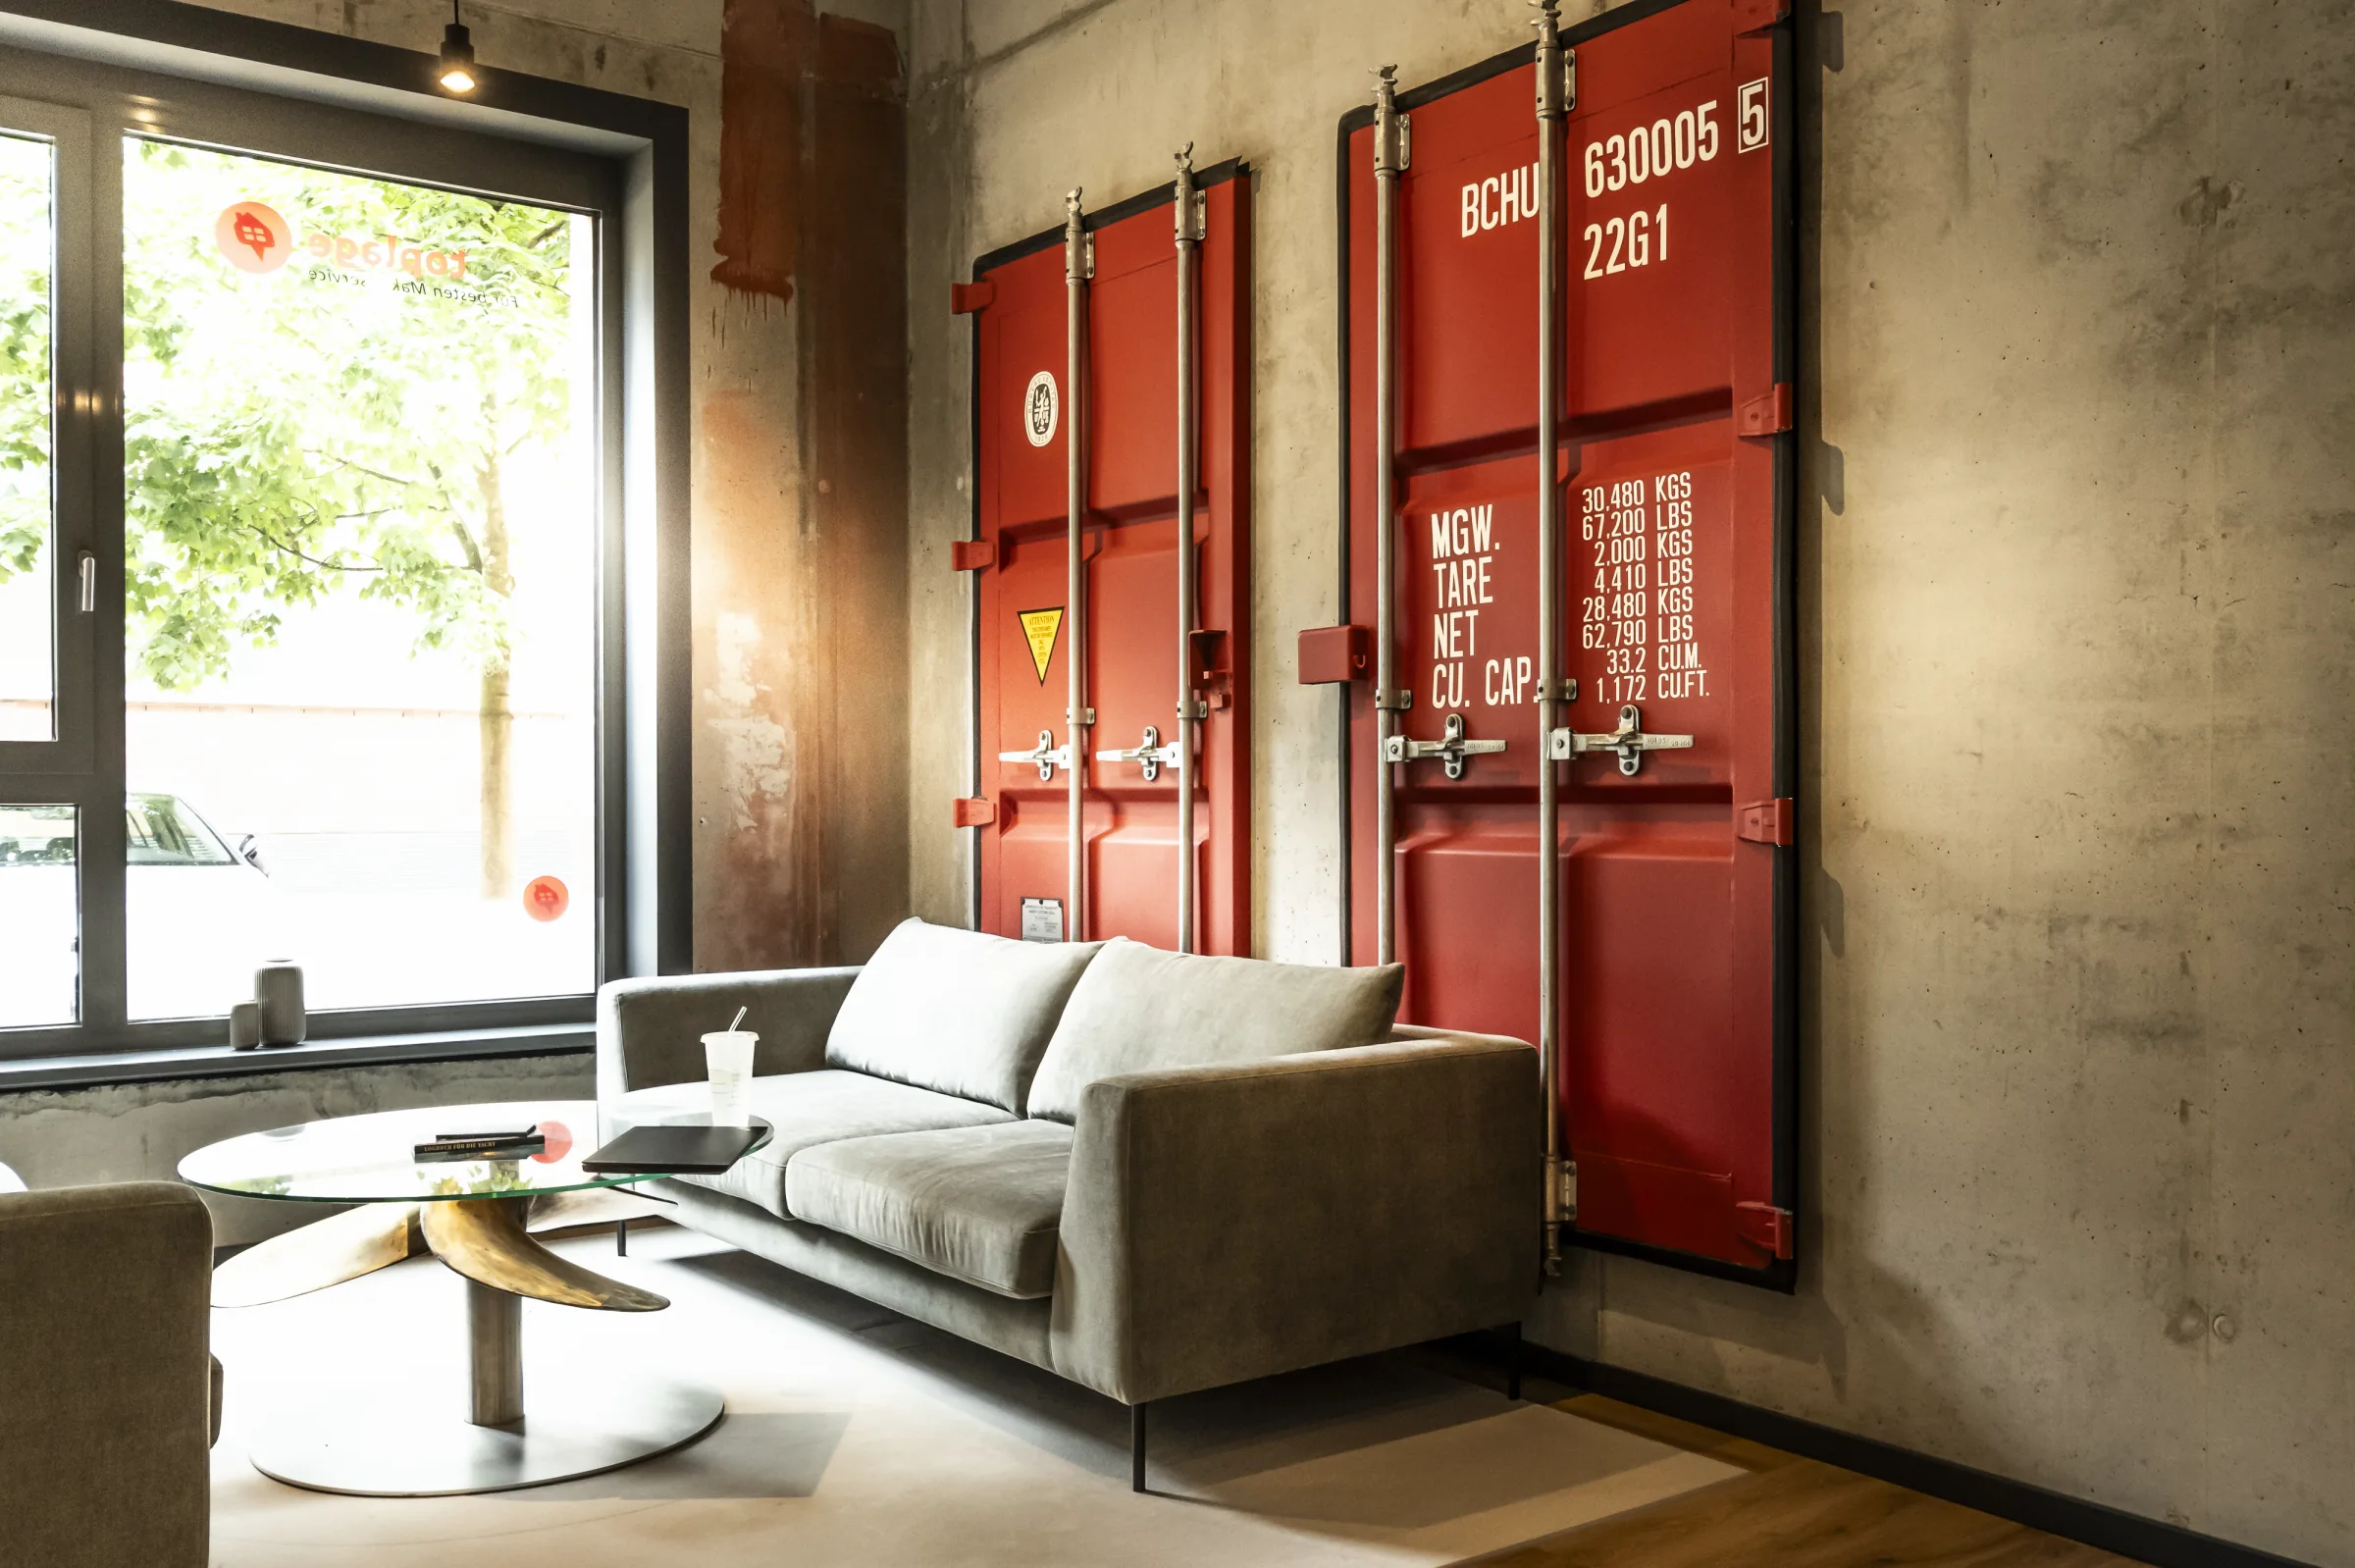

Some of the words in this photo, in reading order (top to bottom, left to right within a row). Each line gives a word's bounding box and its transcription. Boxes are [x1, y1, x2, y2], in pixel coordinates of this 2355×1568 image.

[1462, 161, 1540, 238] BCHU
[1585, 99, 1719, 198] 630005
[1742, 82, 1765, 146] 5
[1584, 203, 1668, 281] 22G1
[1582, 479, 1646, 514] 30,480
[1655, 471, 1692, 503] KGS
[1431, 503, 1500, 559] MGW.
[1582, 507, 1647, 541] 67,200
[1656, 499, 1693, 531] LBS
[1594, 535, 1647, 568] 2,000
[1656, 528, 1693, 559] KGS
[1433, 555, 1493, 609] TARE
[1594, 562, 1647, 595] 4,410
[1657, 556, 1694, 588] LBS
[1583, 591, 1647, 623] 28,480
[1657, 585, 1694, 615] KGS
[1434, 608, 1479, 659] NET
[1583, 618, 1647, 650] 62,790
[1657, 613, 1694, 644] LBS
[1606, 647, 1647, 675] 33.2
[1657, 642, 1702, 671] CU.M.
[1432, 661, 1470, 709] CU.
[1485, 655, 1539, 706] CAP.
[1596, 674, 1647, 705] 1,172
[1657, 669, 1710, 700] CU.FT.
